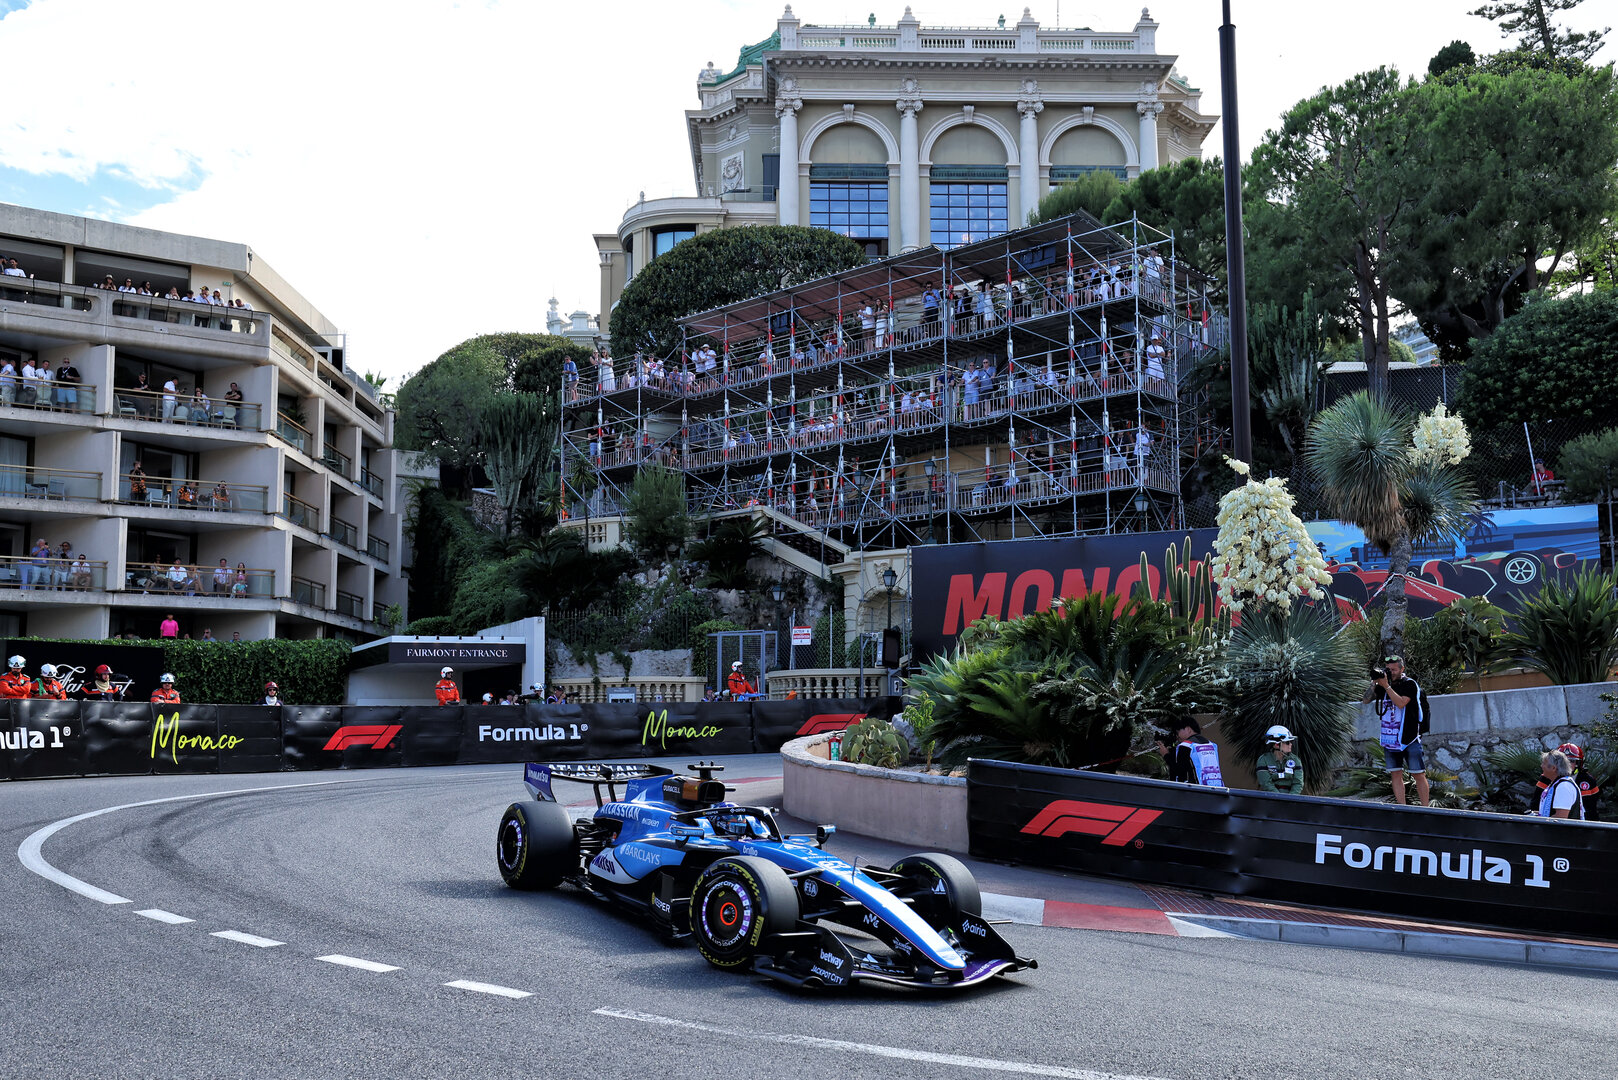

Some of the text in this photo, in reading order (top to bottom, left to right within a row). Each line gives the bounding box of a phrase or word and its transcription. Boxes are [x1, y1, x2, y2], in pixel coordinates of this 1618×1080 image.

[407, 649, 508, 658] FAIRMONT ENTRANCE
[151, 712, 244, 764] Monaco
[479, 725, 565, 741] Formula
[642, 709, 722, 749] Monaco
[600, 803, 640, 820] ATLASSIAN
[625, 844, 661, 866] BARCLAYS
[1315, 833, 1512, 884] Formula
[804, 883, 816, 893] FIA
[970, 923, 987, 938] airia
[820, 948, 844, 969] betway
[811, 965, 844, 984] JACKPOT CITY
